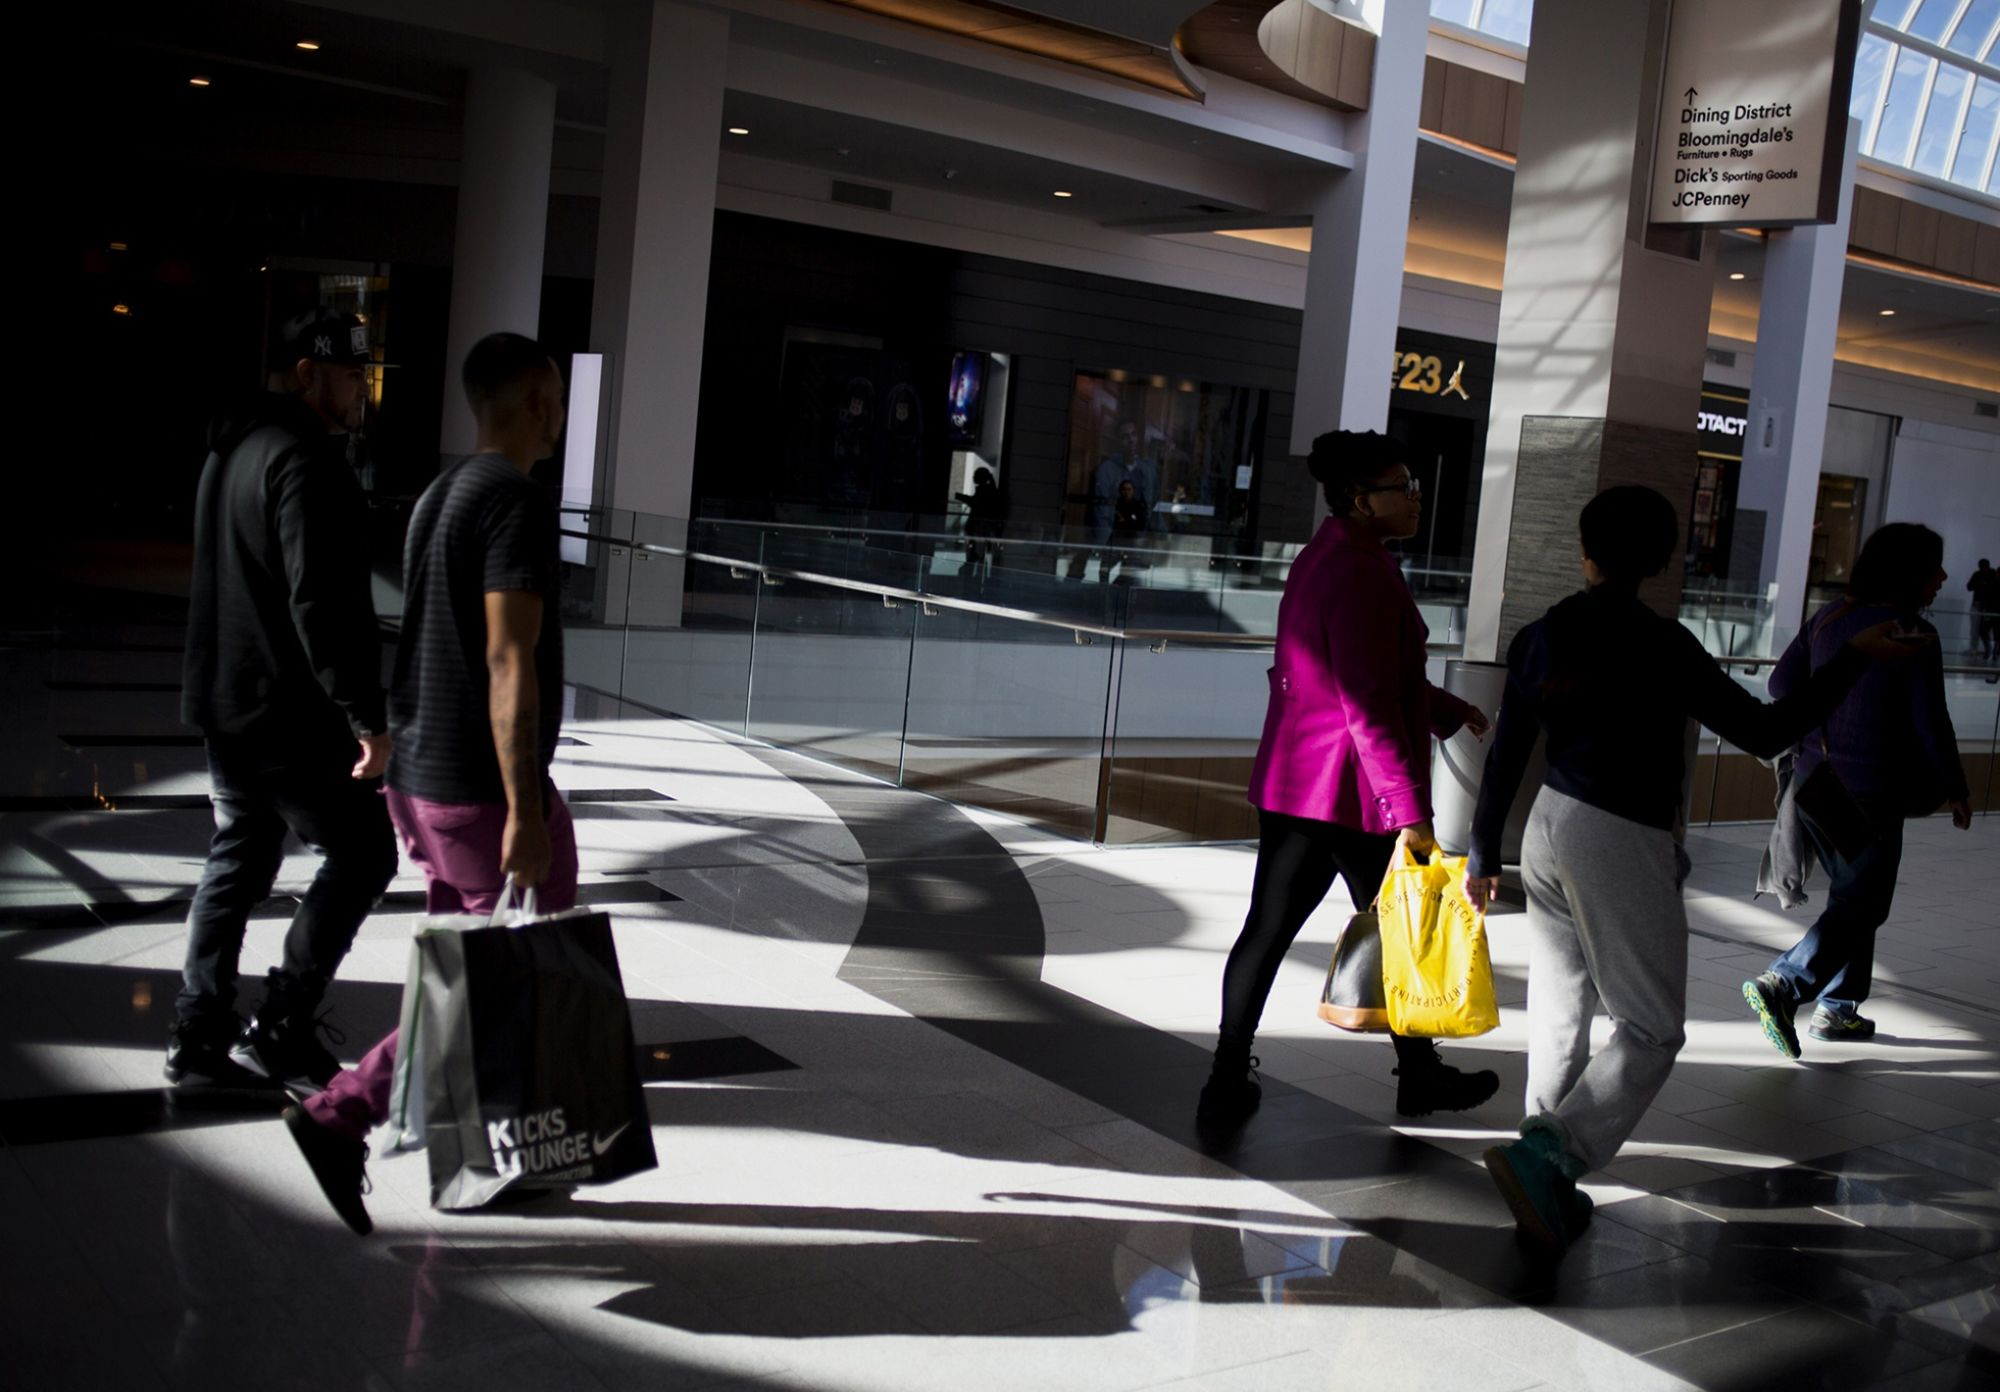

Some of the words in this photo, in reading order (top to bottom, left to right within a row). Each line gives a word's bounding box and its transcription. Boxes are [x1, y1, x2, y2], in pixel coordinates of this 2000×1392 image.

[1681, 107, 1730, 125] Dining
[1734, 103, 1792, 121] District
[1678, 127, 1793, 148] Bloomingdale's
[1677, 150, 1719, 161] Furniture
[1730, 147, 1753, 159] Rugs
[1674, 167, 1718, 184] Dick's
[1722, 171, 1763, 184] Sporting
[1765, 168, 1798, 180] Goods
[1672, 191, 1750, 209] JCPenney
[487, 1107, 568, 1151] KICKS
[493, 1130, 592, 1177] LOUNGE
